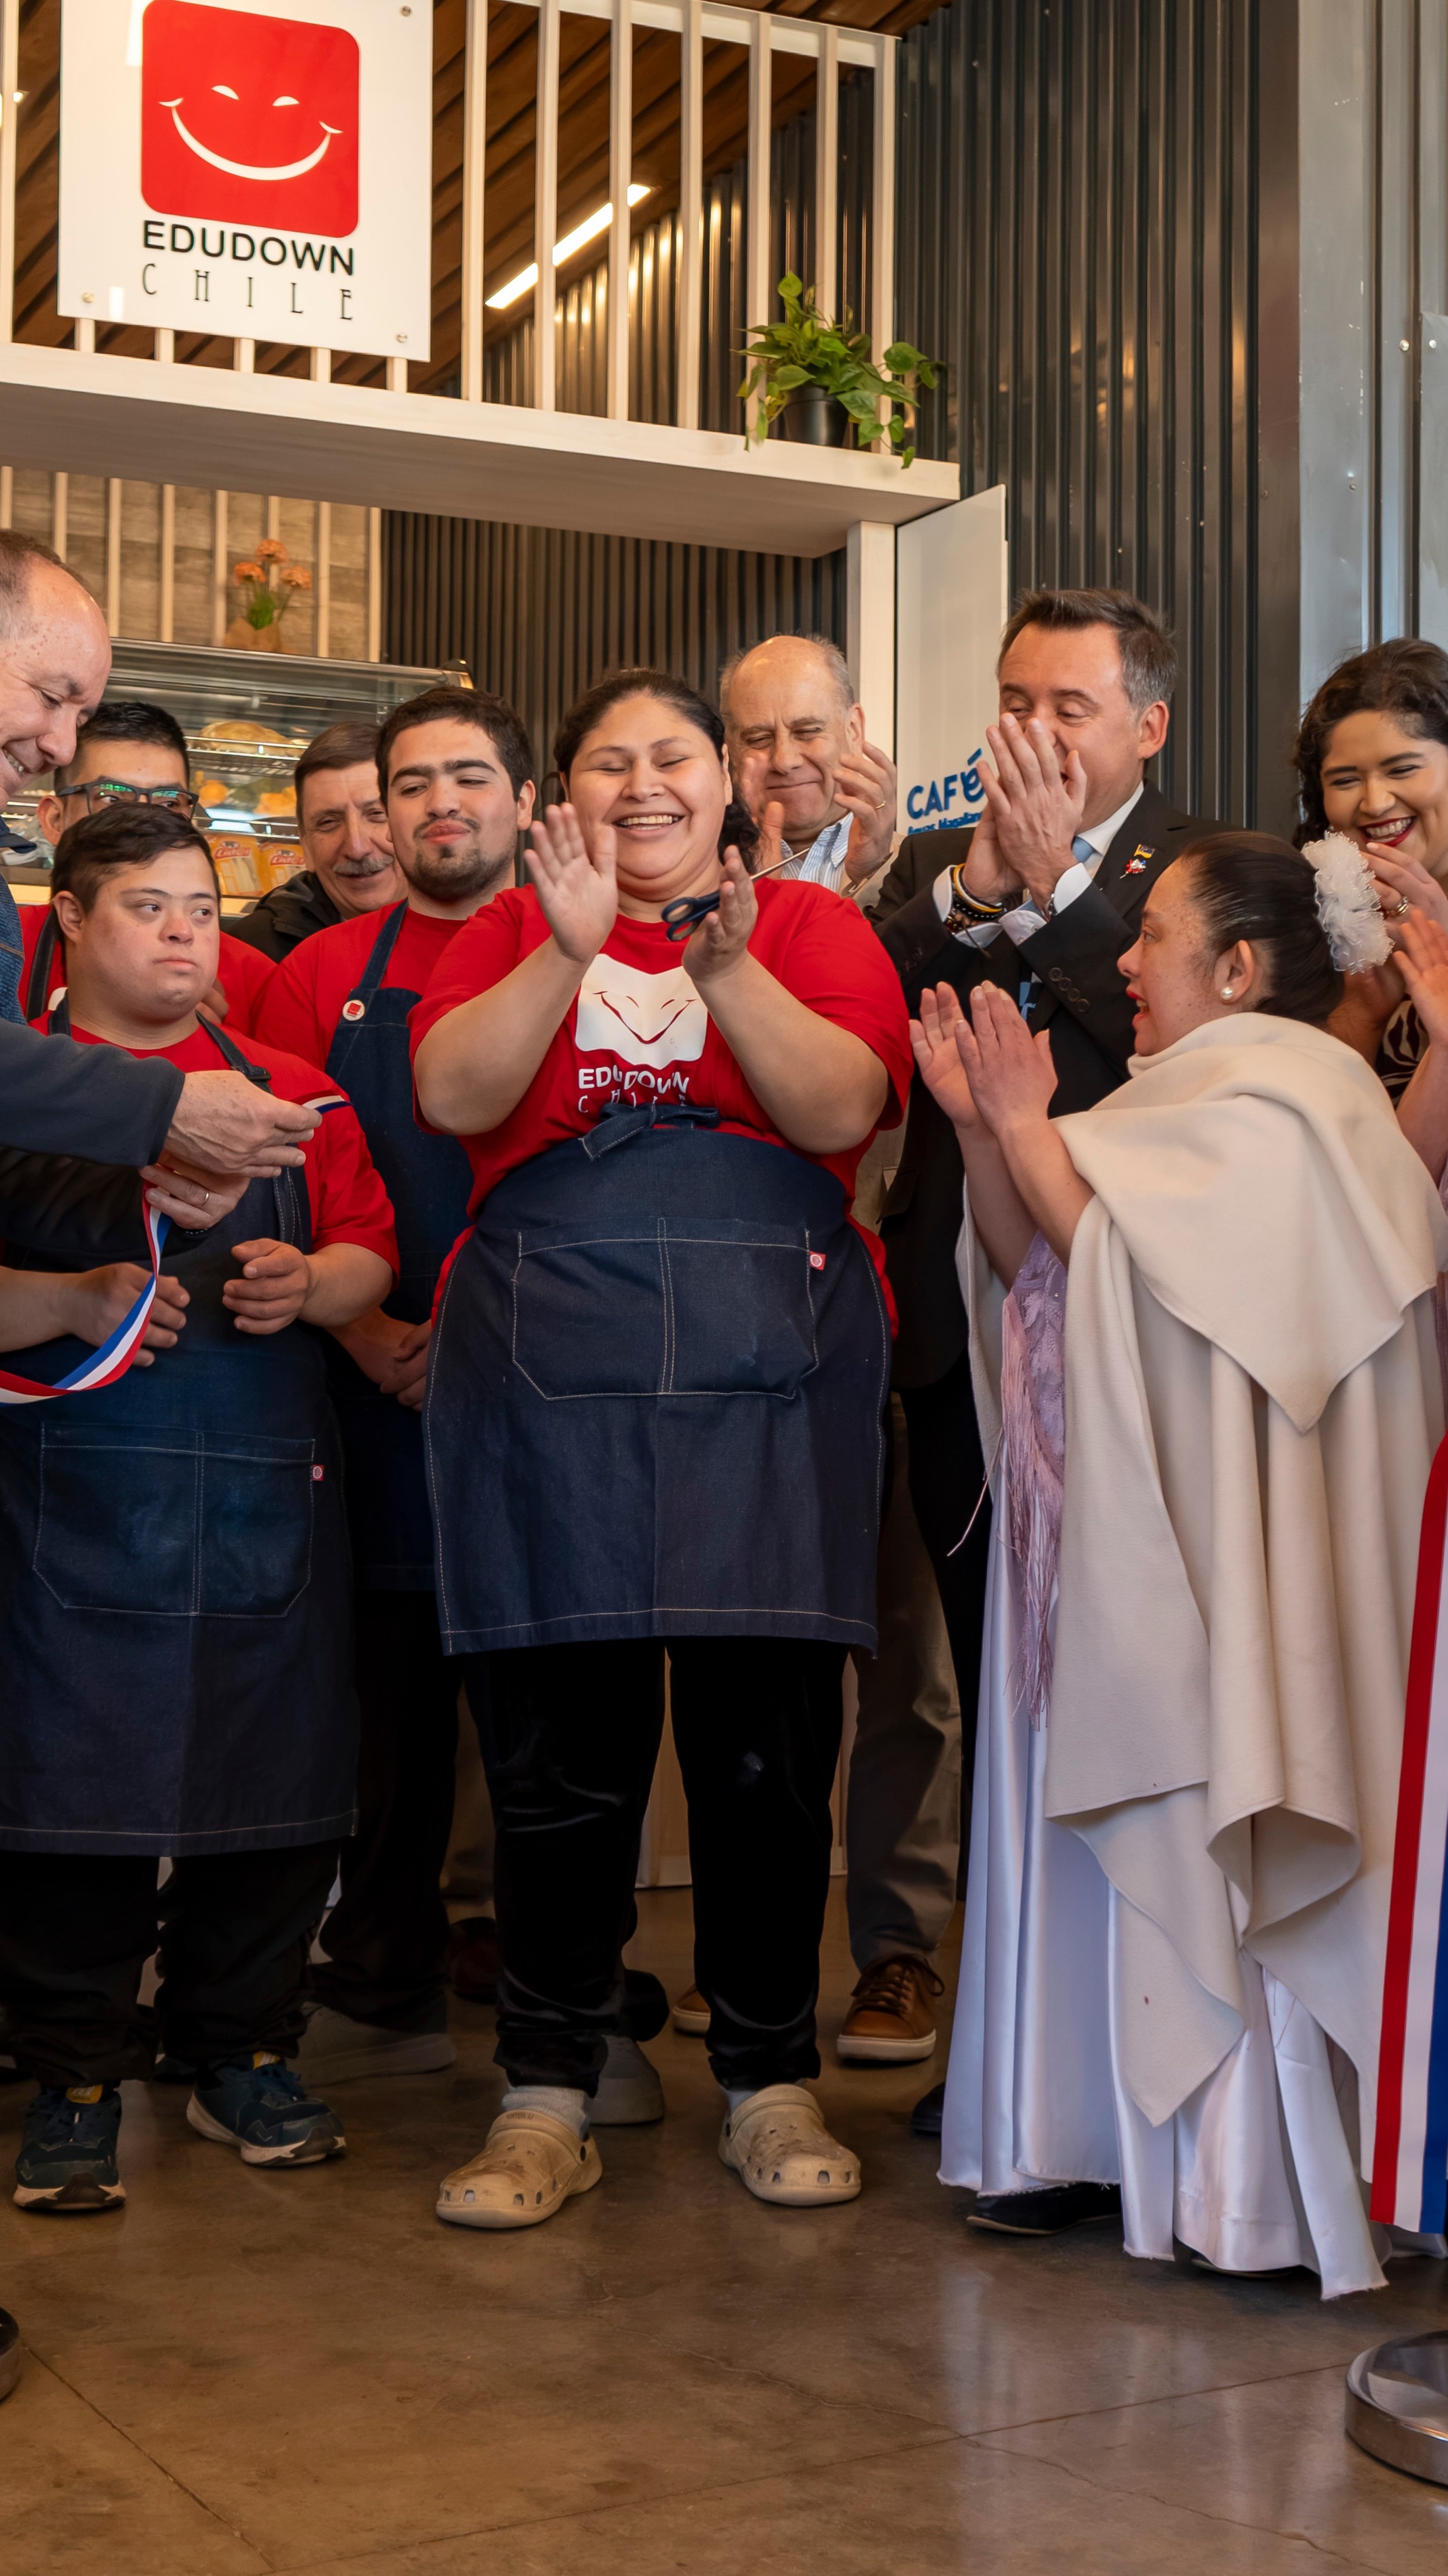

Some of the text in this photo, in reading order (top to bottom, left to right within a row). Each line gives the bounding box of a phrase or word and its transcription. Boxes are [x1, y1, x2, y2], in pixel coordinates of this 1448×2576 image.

[143, 219, 353, 276] EDUDOWN
[142, 262, 353, 320] CHILE
[578, 1064, 690, 1094] EDUDOWN
